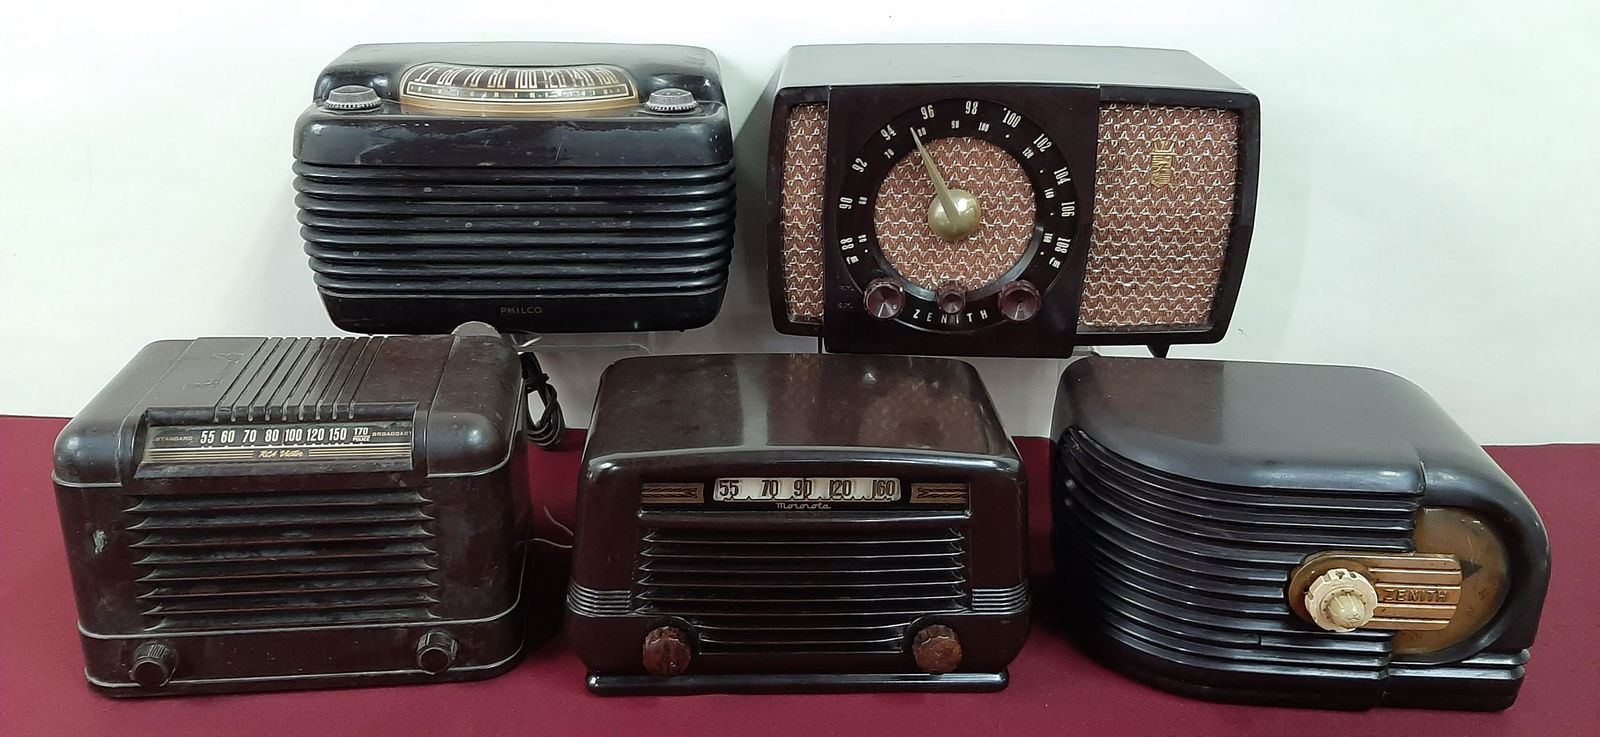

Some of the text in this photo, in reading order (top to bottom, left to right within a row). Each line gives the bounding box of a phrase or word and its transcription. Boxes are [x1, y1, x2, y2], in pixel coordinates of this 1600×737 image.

[514, 69, 538, 88] 100
[920, 104, 935, 120] 96
[965, 100, 979, 115] 98
[1002, 110, 1022, 128] 100
[880, 124, 897, 141] 94
[1033, 133, 1053, 153] 102
[851, 157, 868, 173] 92
[1053, 166, 1072, 186] 104
[839, 196, 853, 210] 90
[1061, 201, 1075, 217] 106
[840, 237, 855, 251] 88
[1054, 237, 1072, 254] 108
[500, 306, 542, 314] PHILCO
[912, 308, 988, 324] ZENITH
[200, 430, 216, 444] 55
[220, 430, 235, 443] 60
[242, 429, 257, 443] 70
[265, 429, 280, 442] 80
[284, 428, 303, 442] 100
[306, 428, 325, 441] 120
[329, 427, 347, 441] 150
[354, 427, 369, 435] 170
[258, 450, 278, 458] RCA
[719, 479, 895, 497] 55 70 90 120 160
[775, 502, 832, 510] Motorola
[1383, 588, 1449, 603] ZENITH
